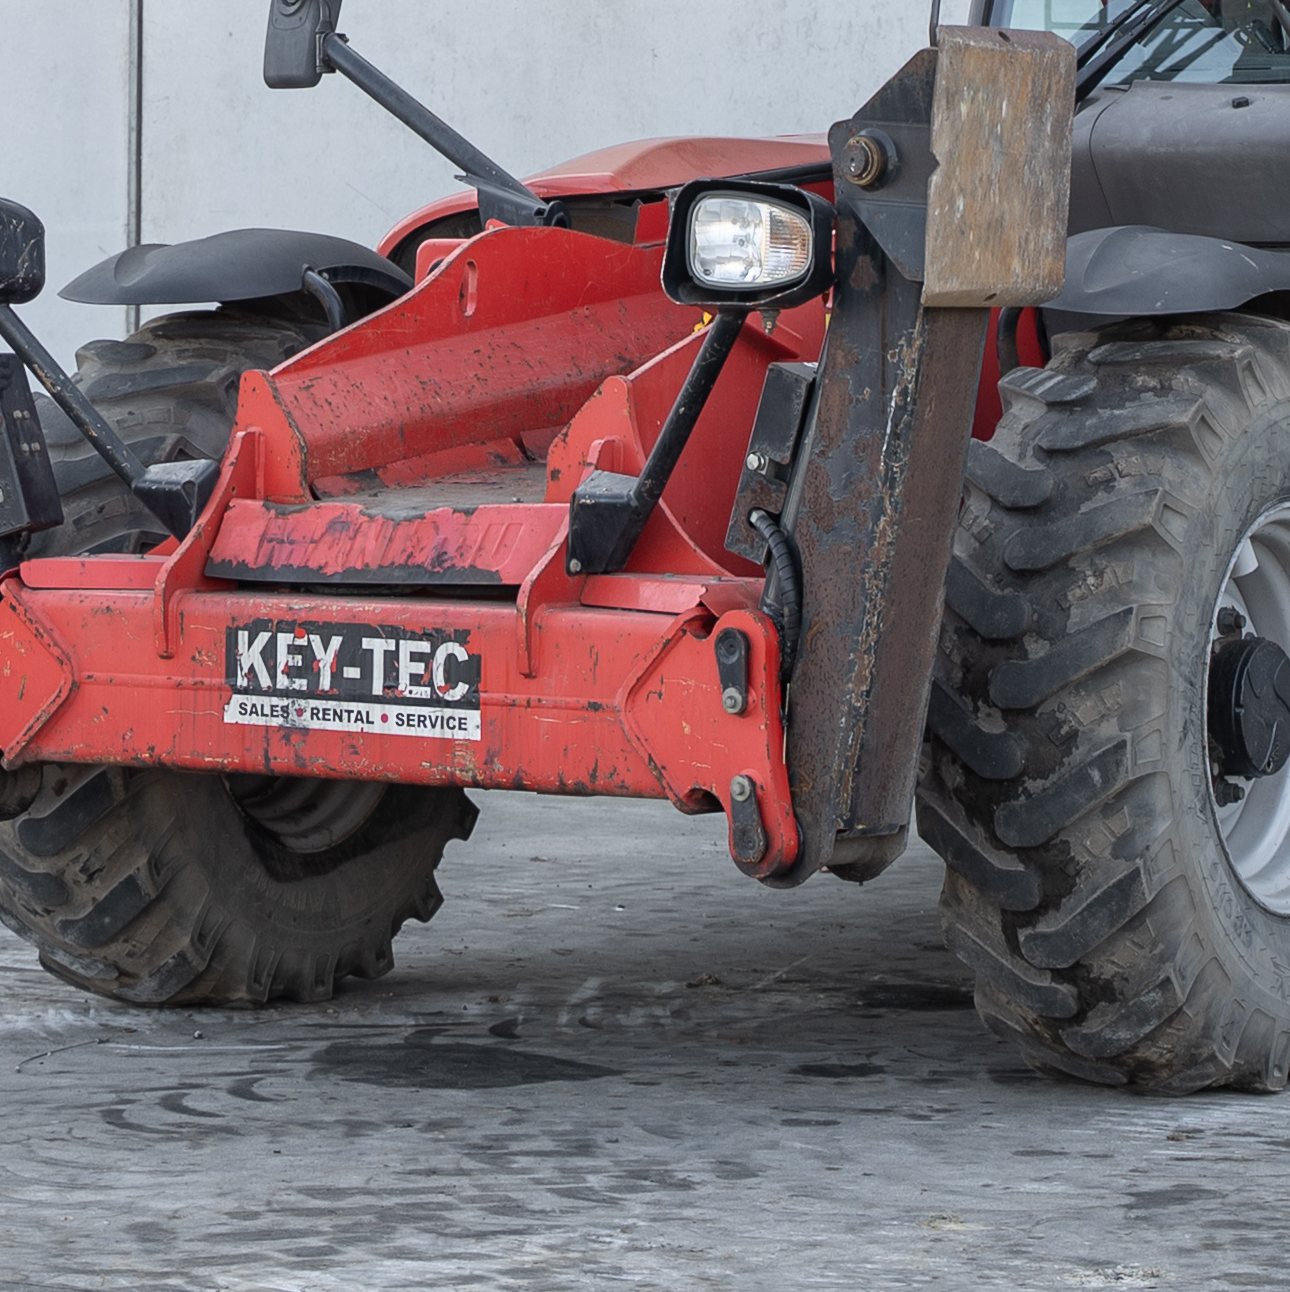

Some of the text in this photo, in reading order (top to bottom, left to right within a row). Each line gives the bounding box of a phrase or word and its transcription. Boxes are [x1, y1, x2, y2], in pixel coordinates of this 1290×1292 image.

[236, 630, 469, 701] KEY-TEC
[238, 702, 468, 731] SALES RENTAL SERVICE
